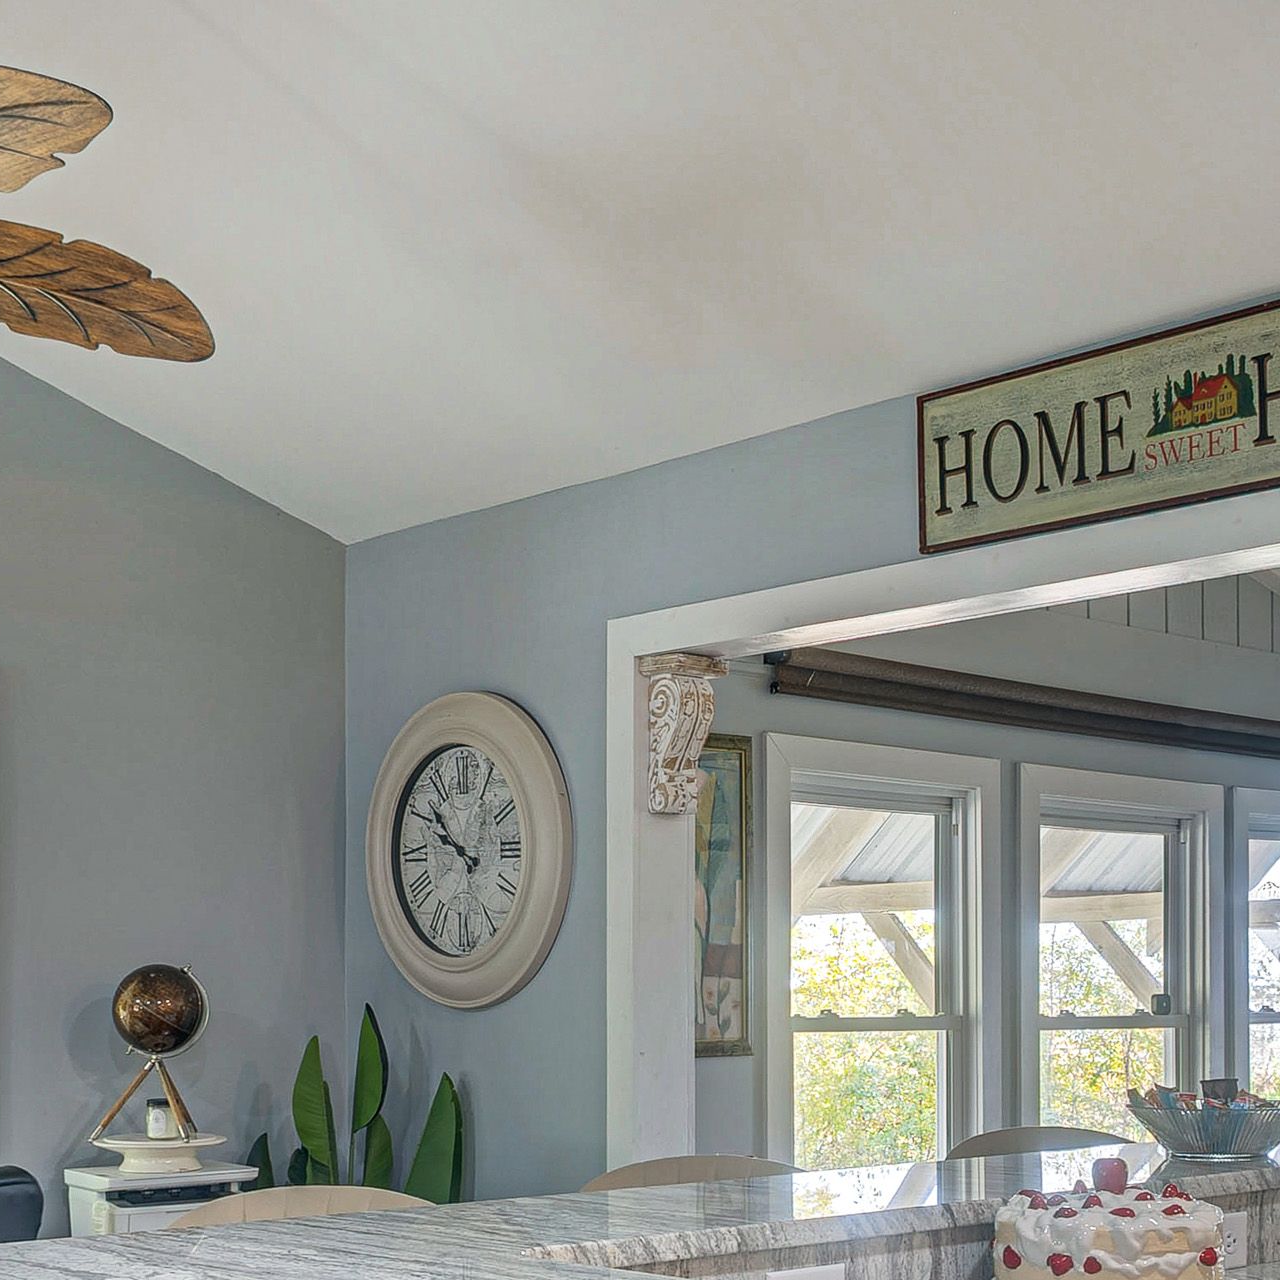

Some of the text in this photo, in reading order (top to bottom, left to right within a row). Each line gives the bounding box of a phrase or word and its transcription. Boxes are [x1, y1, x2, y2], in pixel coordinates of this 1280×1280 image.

[933, 390, 1137, 516] HOME
[1144, 423, 1248, 473] SWEET
[500, 837, 521, 860] III
